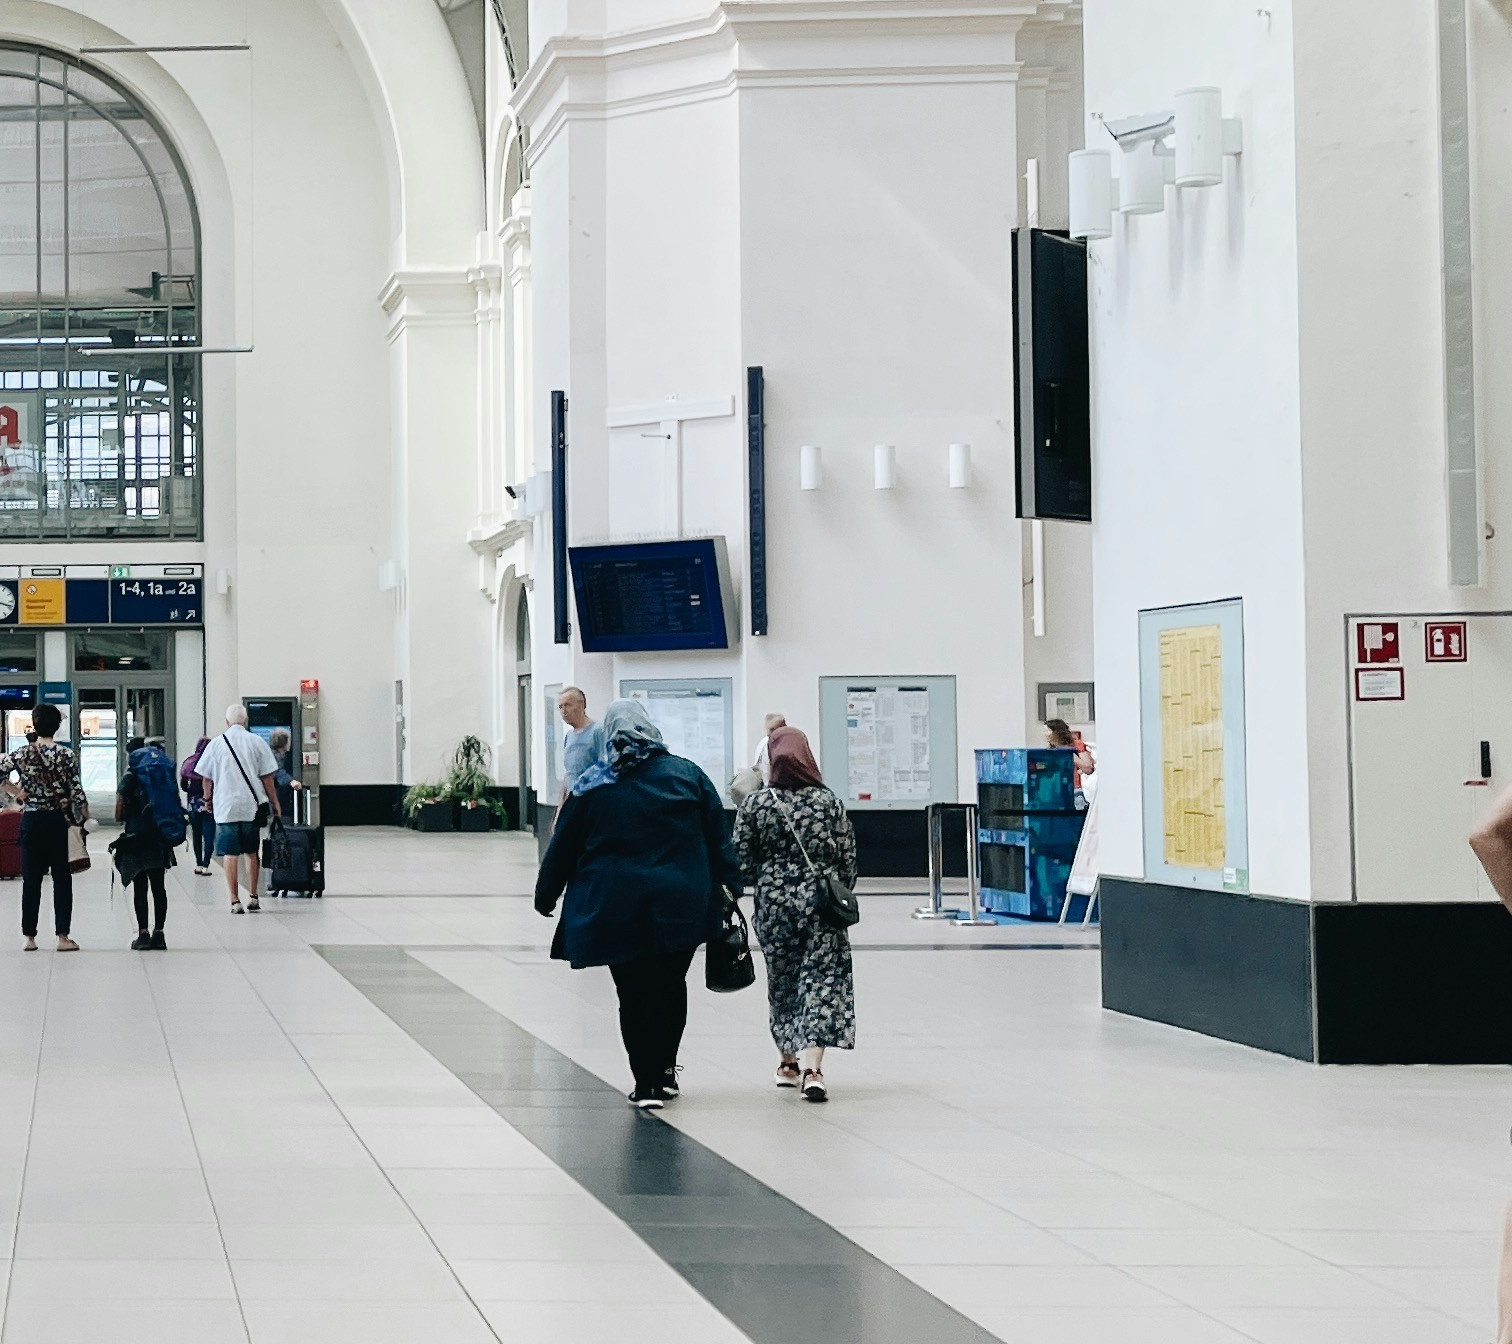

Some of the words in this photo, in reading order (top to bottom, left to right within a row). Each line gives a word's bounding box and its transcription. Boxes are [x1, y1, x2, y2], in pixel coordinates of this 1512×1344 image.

[119, 581, 145, 597] 1-4,
[147, 581, 164, 596] 1a
[178, 581, 196, 595] 2a
